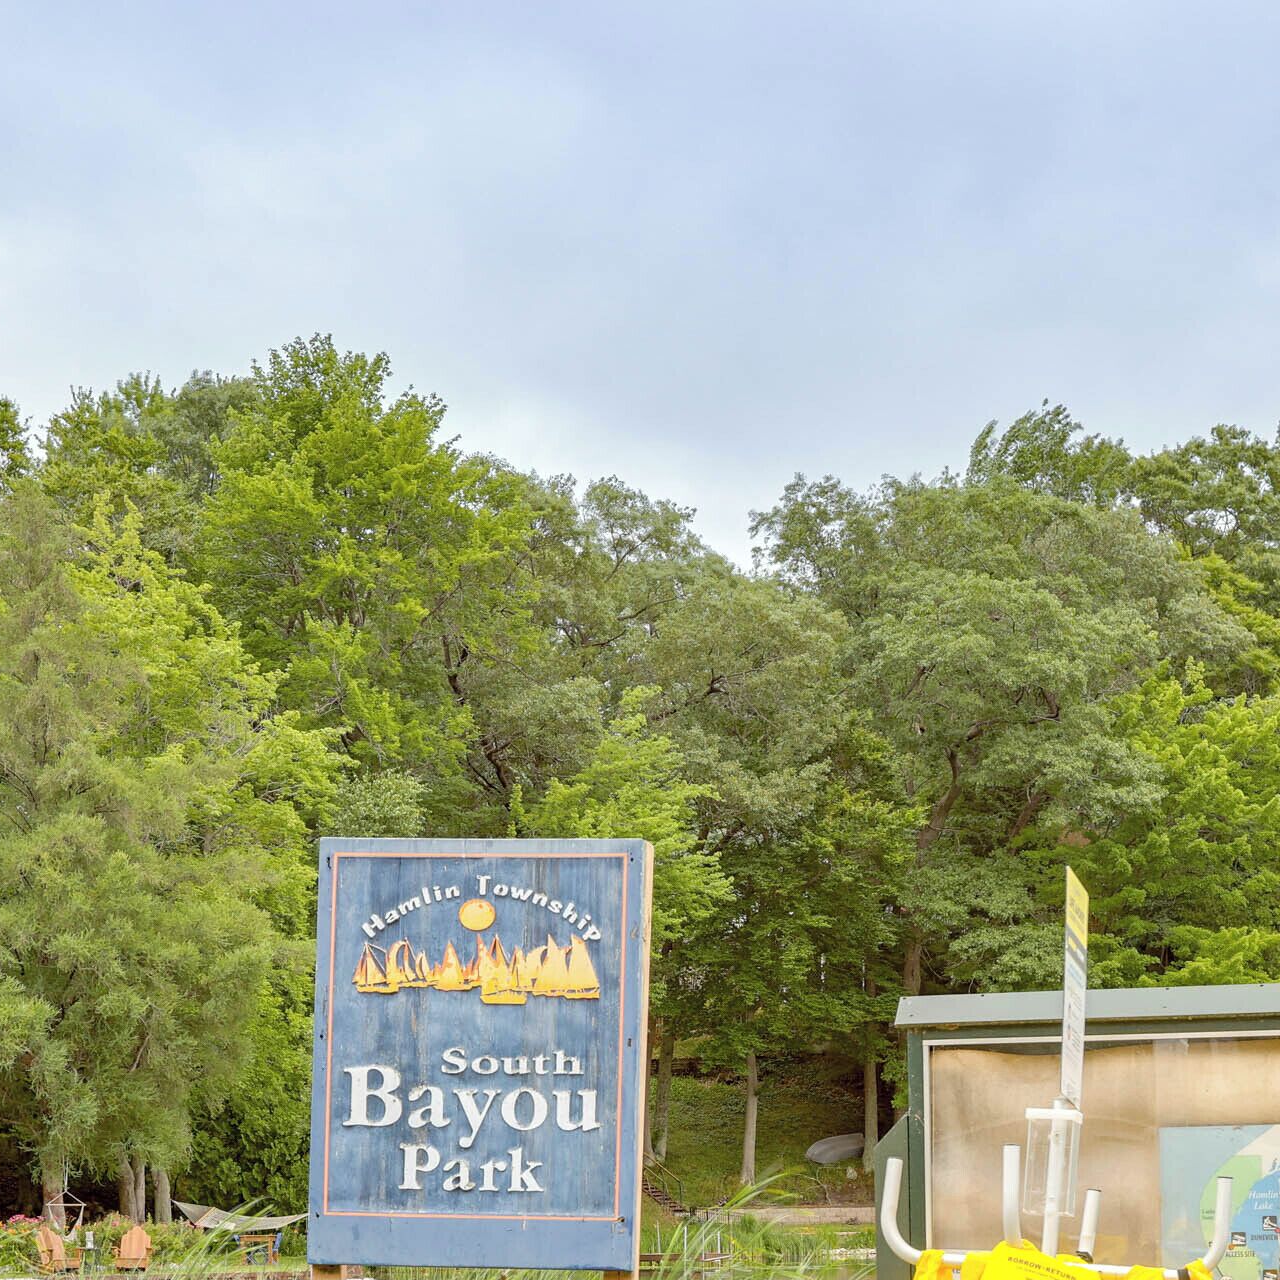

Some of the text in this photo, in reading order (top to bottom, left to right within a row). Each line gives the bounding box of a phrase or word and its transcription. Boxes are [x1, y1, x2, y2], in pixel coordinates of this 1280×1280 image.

[361, 875, 602, 942] Hamlin Township
[440, 1047, 584, 1076] South
[342, 1064, 602, 1148] Bayou
[398, 1142, 545, 1194] Park
[1248, 1190, 1280, 1200] Hamlin
[1254, 1202, 1273, 1211] Lake
